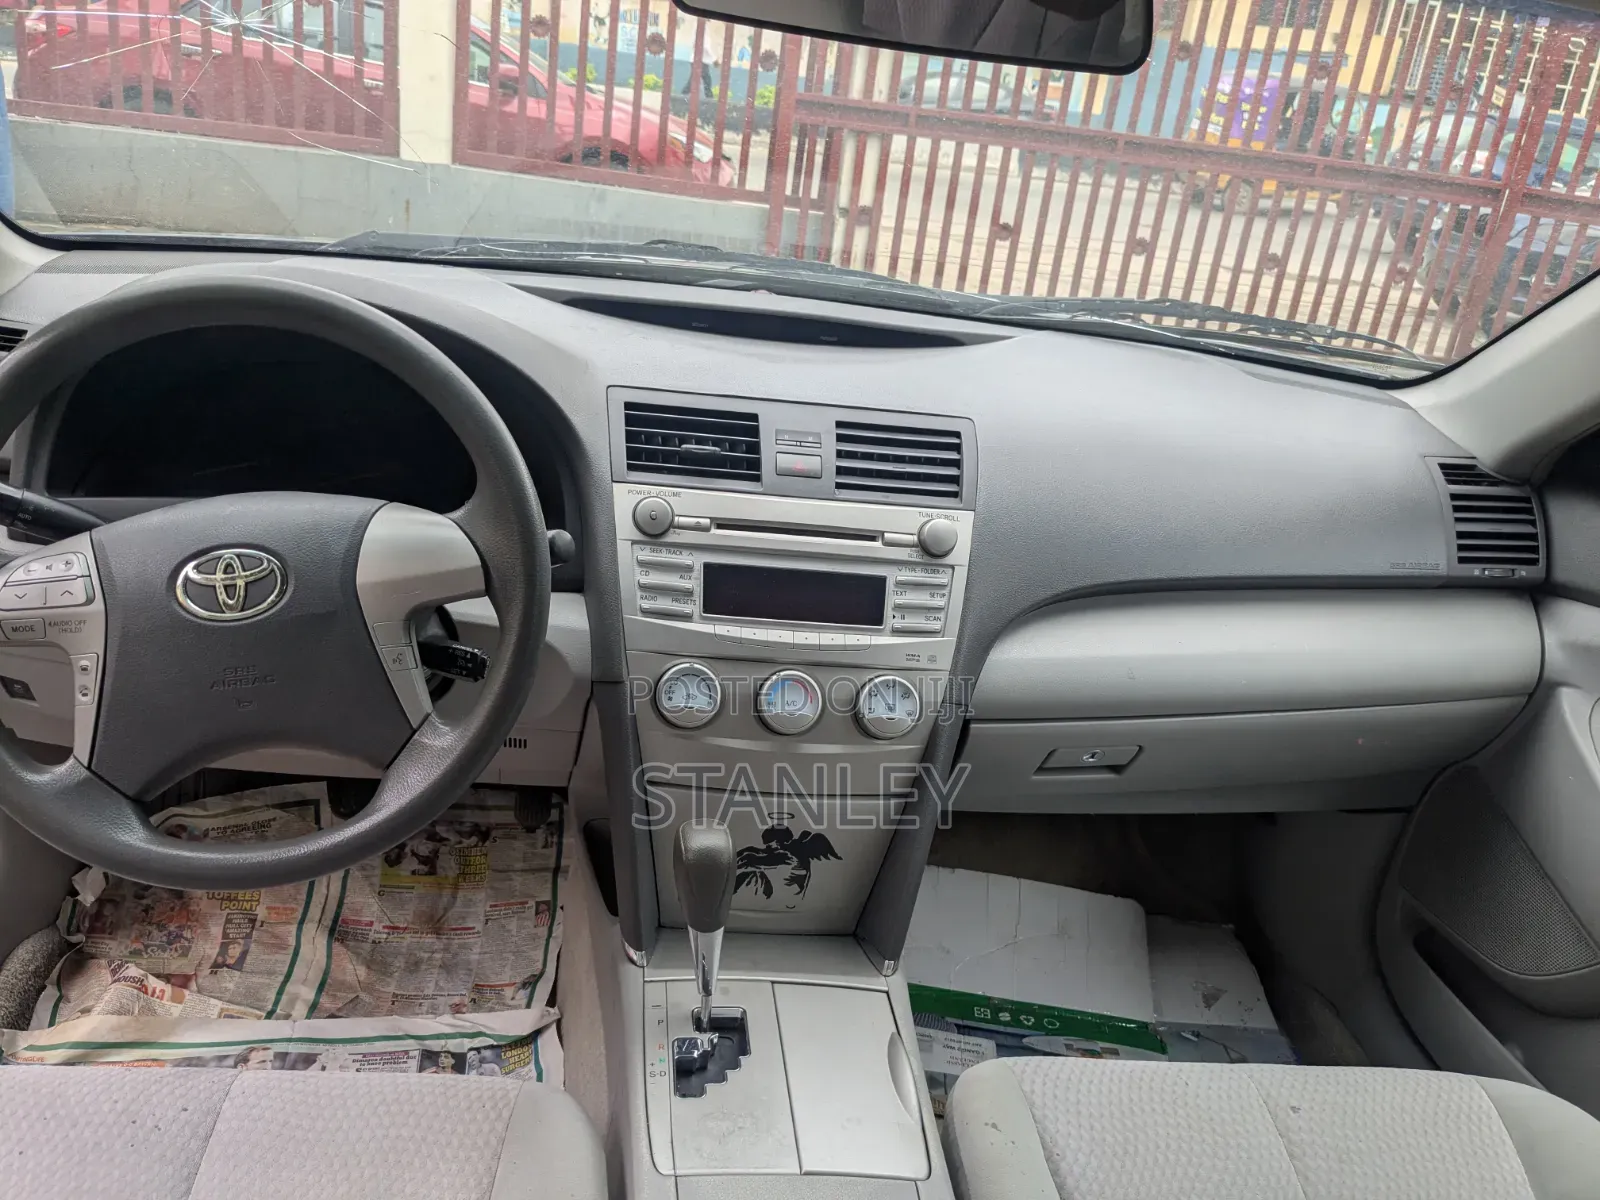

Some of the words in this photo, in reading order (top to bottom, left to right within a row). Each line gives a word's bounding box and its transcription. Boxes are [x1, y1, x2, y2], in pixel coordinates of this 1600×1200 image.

[672, 597, 696, 606] PRESETS
[11, 624, 36, 633] MODE
[206, 891, 261, 900] TOFFEES
[220, 900, 260, 912] POINT
